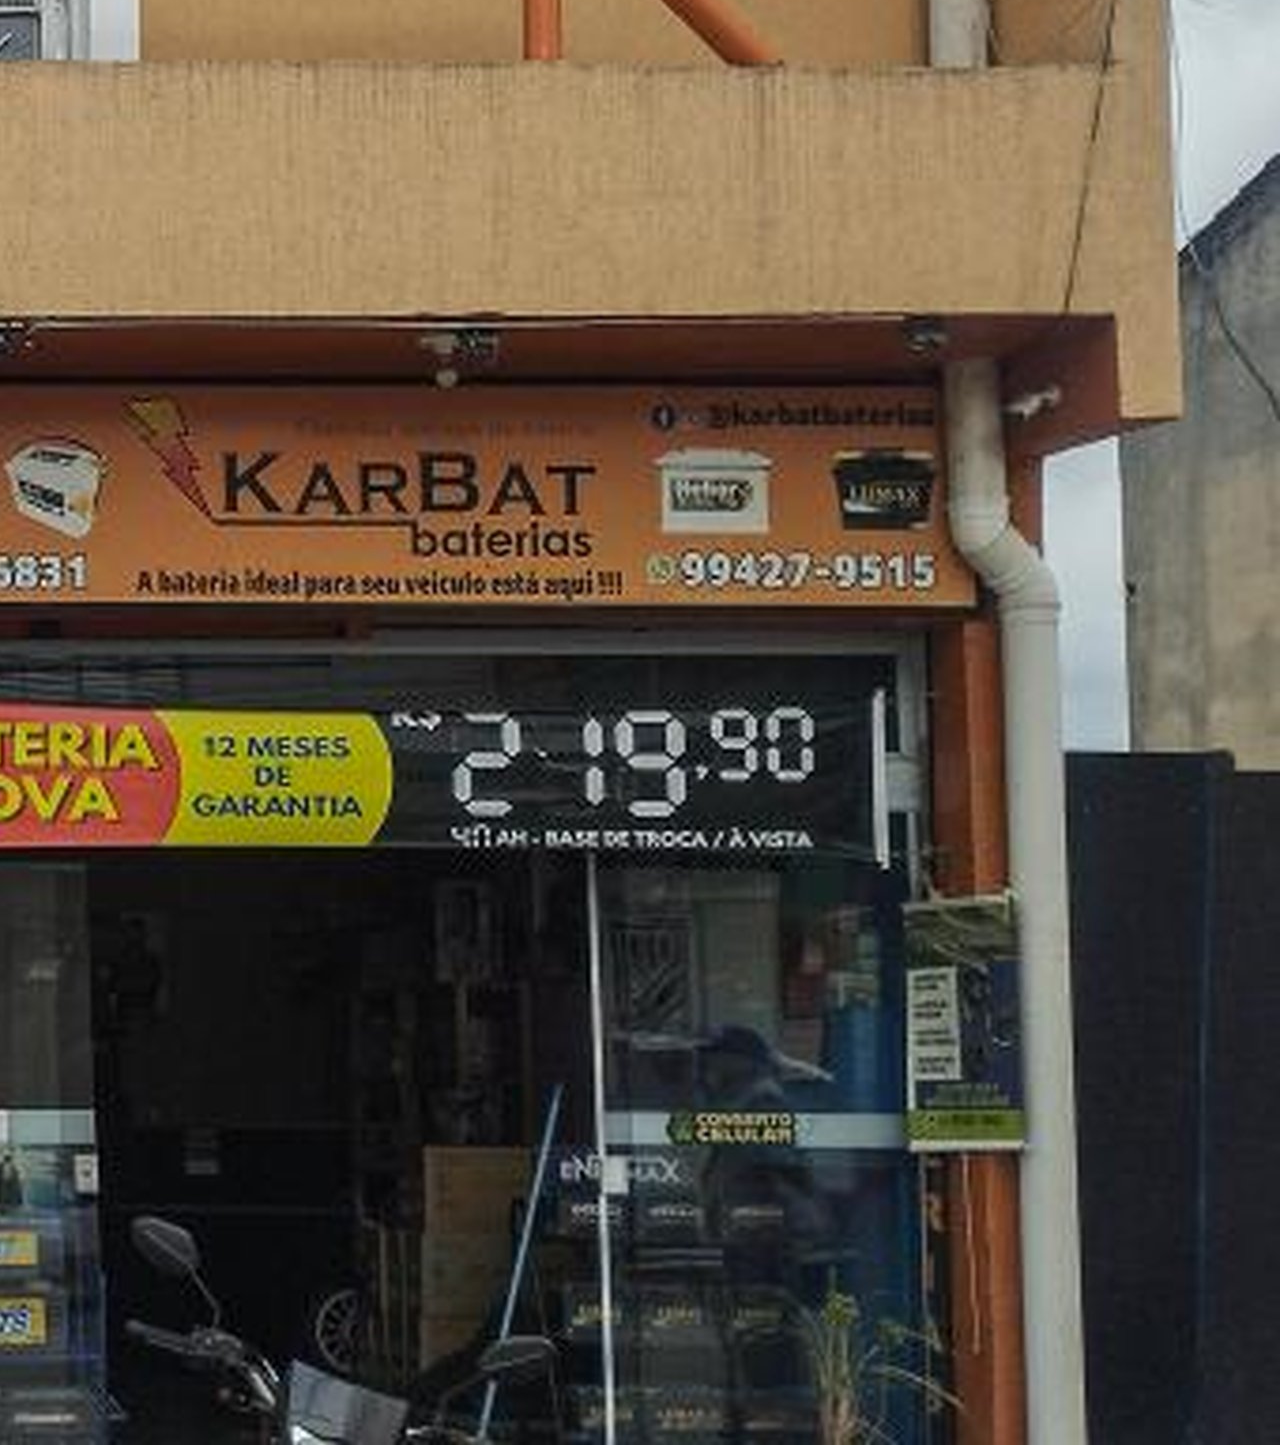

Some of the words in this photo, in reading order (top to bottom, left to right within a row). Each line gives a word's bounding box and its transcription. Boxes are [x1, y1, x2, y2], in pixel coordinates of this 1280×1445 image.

[411, 521, 592, 558] baterias
[680, 551, 936, 590] 99427-9515
[137, 570, 153, 595] A
[158, 570, 241, 596] bateria
[245, 570, 299, 596] ideal
[304, 575, 357, 600] para
[362, 576, 400, 596] seu
[490, 570, 539, 596] está
[543, 570, 593, 600] aqui
[204, 736, 237, 758] 12
[247, 735, 351, 758] MESES
[254, 766, 292, 788] DE
[192, 794, 363, 819] GARANTIA
[545, 830, 598, 848] BASE
[604, 830, 628, 848] DE
[633, 830, 708, 848] TROCA
[748, 830, 813, 848] VISTA
